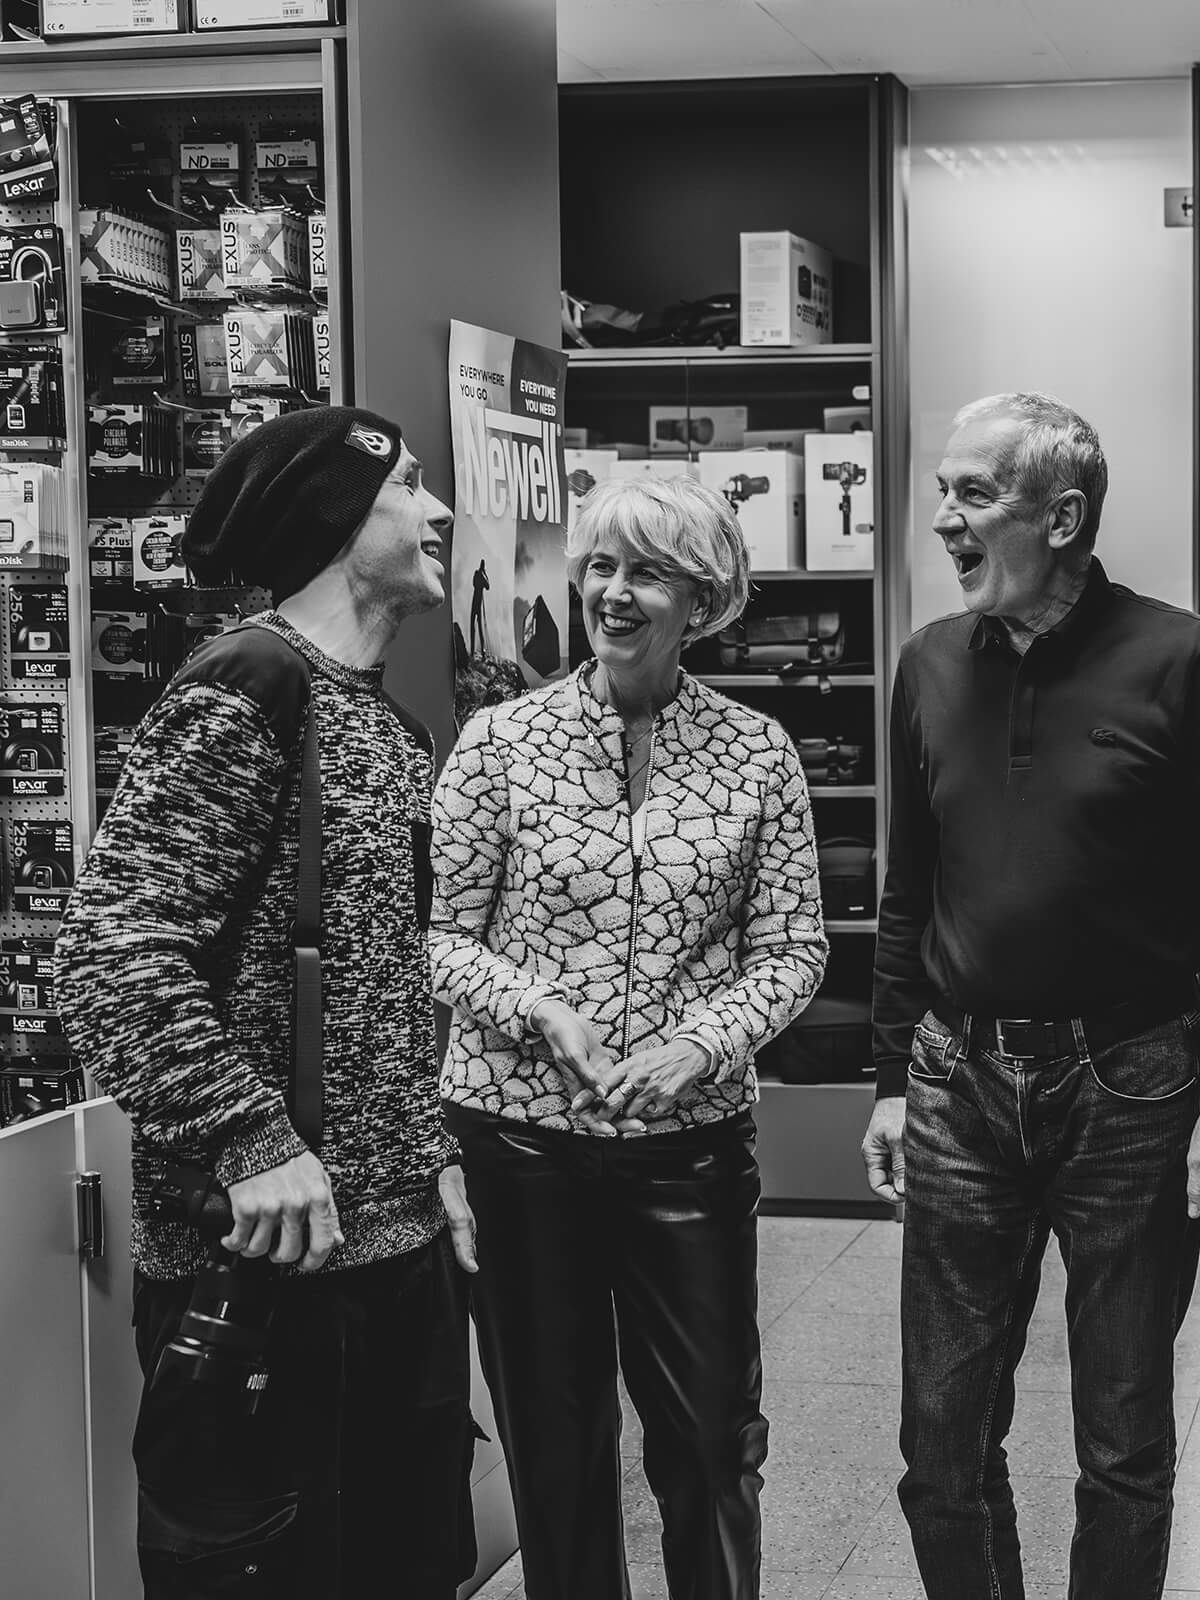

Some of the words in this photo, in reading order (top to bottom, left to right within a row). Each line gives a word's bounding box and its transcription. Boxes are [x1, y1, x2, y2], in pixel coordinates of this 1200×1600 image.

[188, 155, 209, 168] ND
[265, 153, 287, 167] ND
[3, 177, 46, 198] Lexar
[223, 221, 238, 274] EXUS
[311, 223, 325, 275] EXUS
[180, 235, 194, 287] EXUS
[181, 333, 194, 380] EXUS
[228, 320, 243, 374] EXUS
[316, 323, 330, 375] EXUS
[460, 364, 505, 387] EVERYWHERE
[460, 383, 475, 398] YOU
[476, 387, 488, 401] GO
[520, 379, 557, 400] EVERYTIME
[525, 398, 539, 413] YOU
[540, 402, 557, 417] NEED
[2, 439, 30, 447] SanDisk
[462, 406, 562, 524] Newell
[109, 536, 131, 546] Plus
[0, 556, 23, 565] nDisk
[10, 592, 23, 623] 256
[25, 660, 57, 672] Lexar
[12, 778, 48, 789] Lexar
[14, 825, 28, 857] 256
[29, 895, 62, 907] Lexar
[13, 1015, 47, 1028] Lexar
